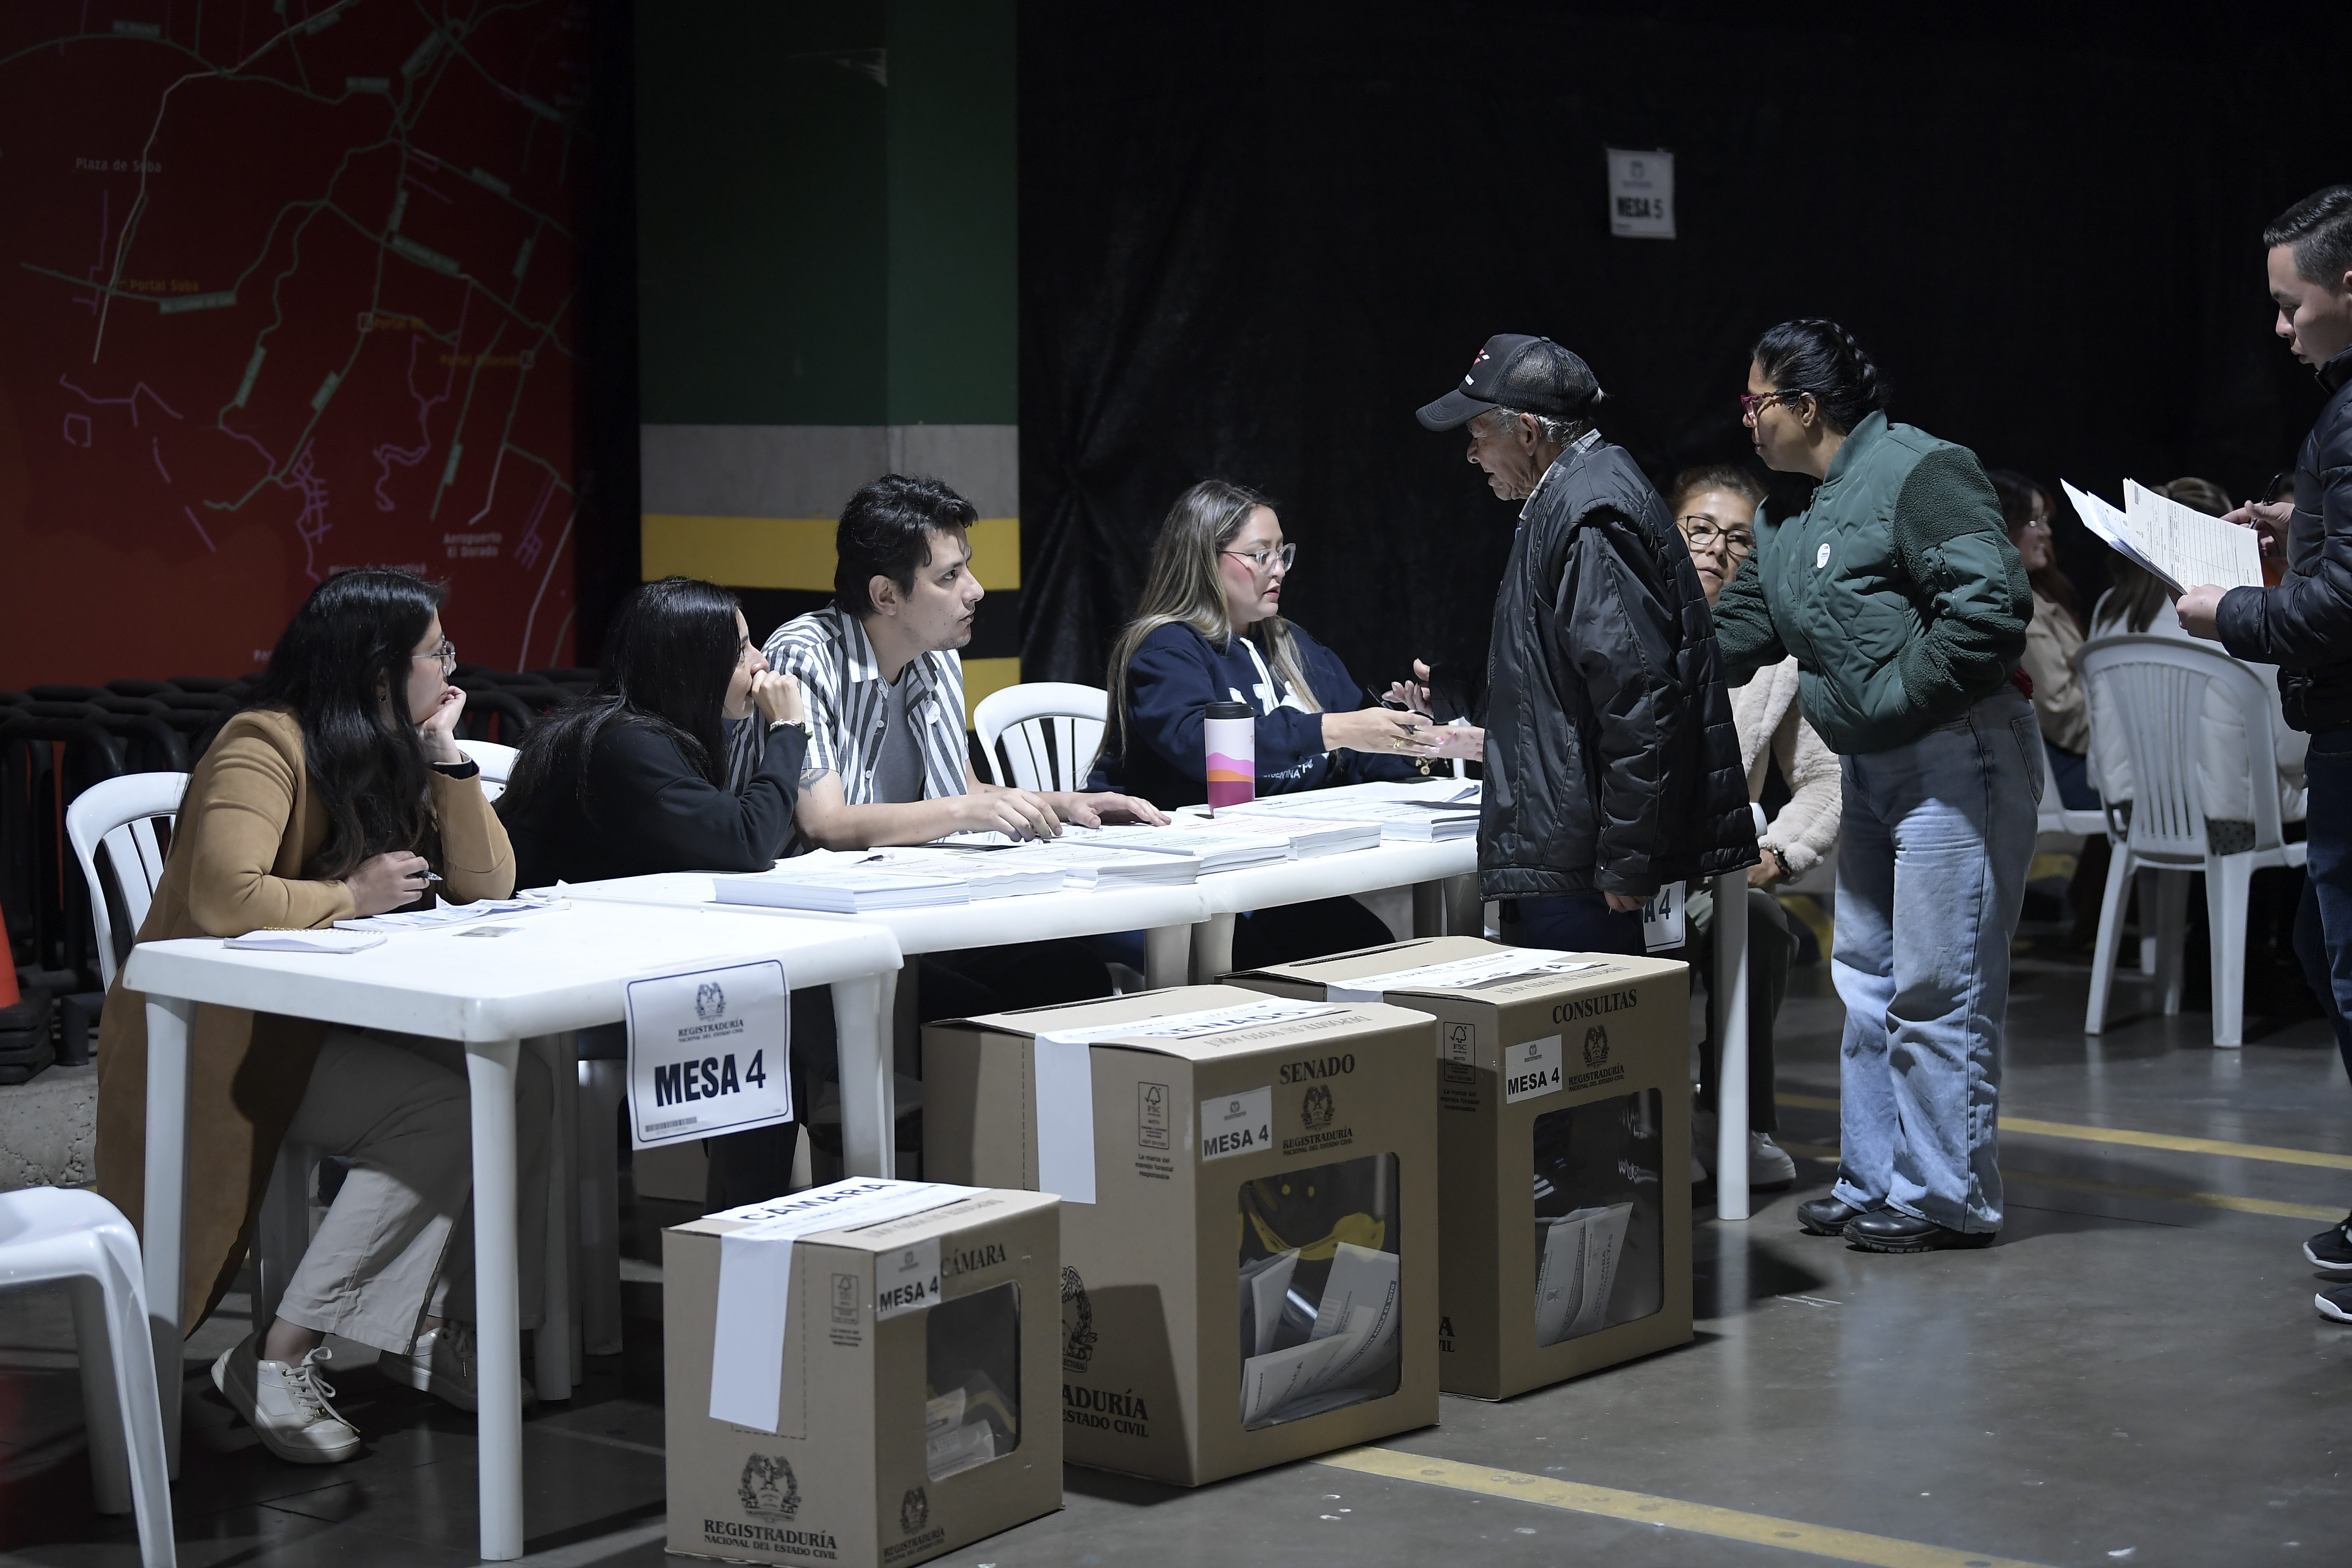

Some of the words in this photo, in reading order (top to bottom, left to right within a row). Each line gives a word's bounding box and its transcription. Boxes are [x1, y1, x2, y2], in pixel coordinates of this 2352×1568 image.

[76, 158, 108, 169] Plaza
[113, 159, 127, 171] de
[133, 160, 162, 173] Suba
[1654, 199, 1663, 219] 5
[130, 279, 166, 291] Portal
[1659, 889, 1671, 920] 4
[1553, 989, 1637, 1024] CONSULTAS
[678, 1018, 743, 1036] REGISTRADURÍA
[1145, 1011, 1308, 1035] SENADO
[655, 1054, 740, 1107] MESA
[746, 1049, 766, 1089] 4
[1280, 1054, 1355, 1084] SENADO
[1508, 1071, 1547, 1095] MESA
[1552, 1067, 1560, 1083] 4
[1569, 1063, 1624, 1085] REGISTRADURÍA
[1569, 1083, 1589, 1092] NACIONAL
[1598, 1077, 1614, 1085] ESTADO
[1444, 1105, 1476, 1113] responsable
[1204, 1129, 1254, 1156] MESA
[1259, 1124, 1269, 1141] 4
[1283, 1126, 1353, 1149] REGISTRADURÍA
[740, 1183, 898, 1220] CÁMARA
[942, 1243, 1006, 1279] CÁMARA
[881, 1282, 924, 1312] MESA
[930, 1276, 939, 1294] 4
[1360, 1336, 1375, 1353] LISTA
[1372, 1314, 1387, 1336] ANULA
[1383, 1304, 1391, 1313] EL
[1387, 1283, 1396, 1303] VOTO
[1114, 1420, 1149, 1437] CIVIL
[704, 1519, 837, 1549] REGISTRADURÍA
[705, 1534, 750, 1548] NACIONAL
[753, 1541, 770, 1550] DEL
[774, 1544, 811, 1556] ESTADO
[813, 1549, 837, 1560] CIVIL
